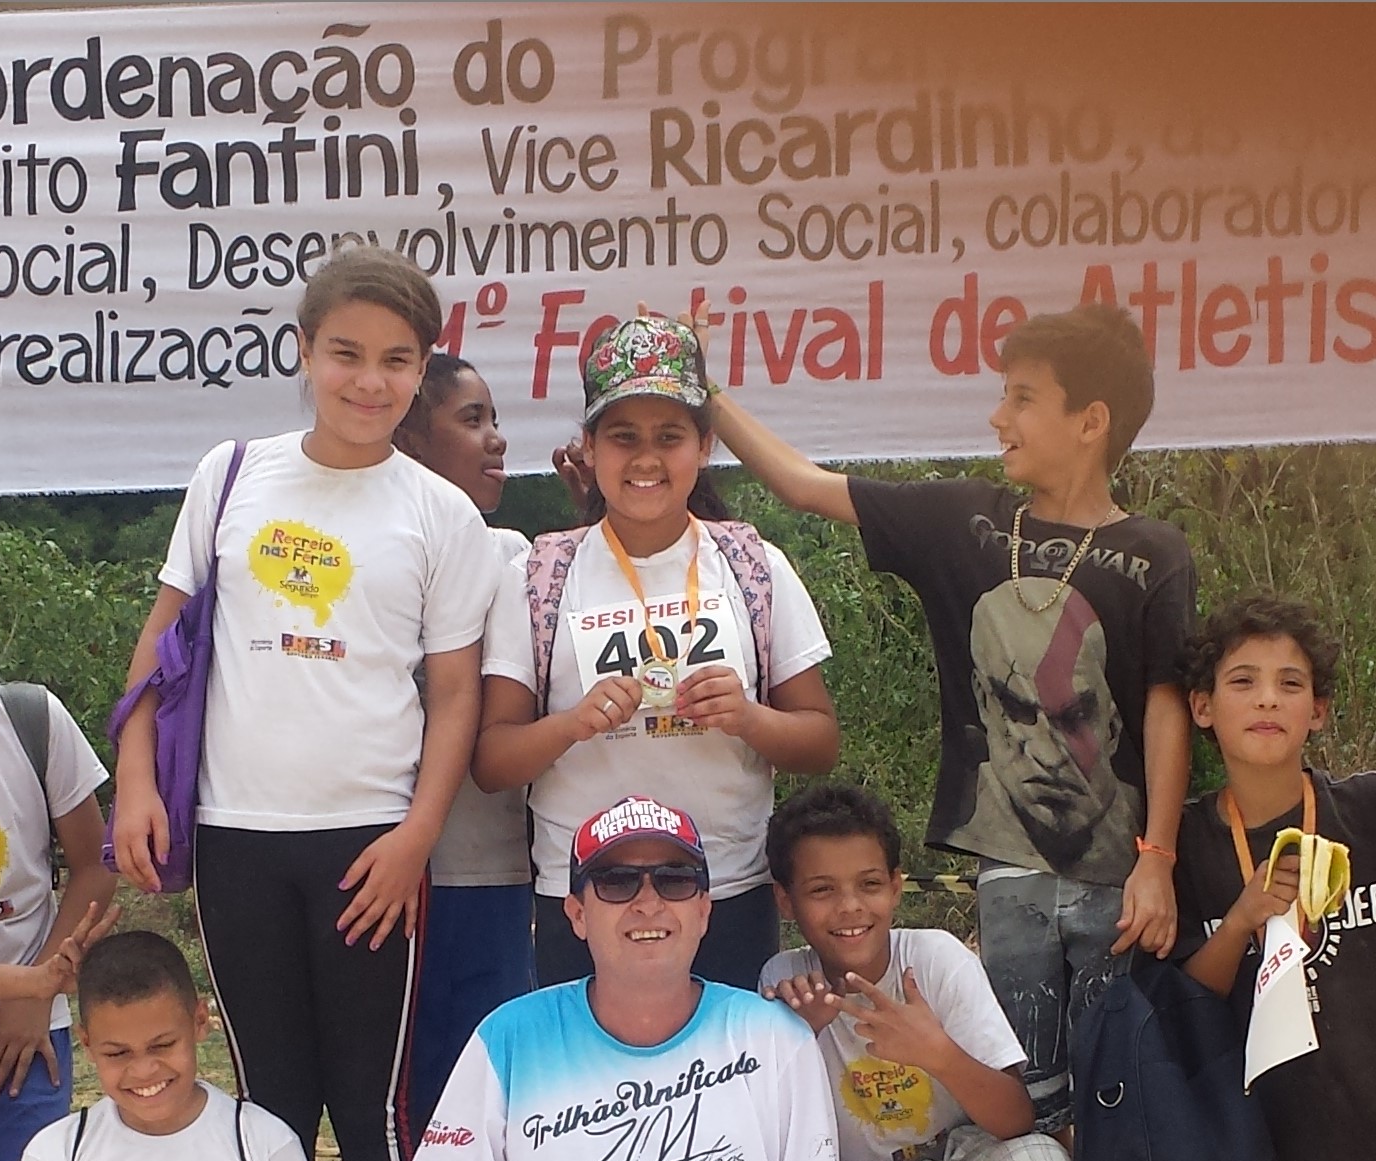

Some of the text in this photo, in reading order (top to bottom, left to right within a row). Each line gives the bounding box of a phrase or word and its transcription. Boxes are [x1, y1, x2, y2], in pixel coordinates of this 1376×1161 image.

[453, 19, 556, 106] do
[603, 20, 934, 113] Progra
[482, 123, 620, 196] Vice
[757, 183, 965, 262] Social,
[531, 281, 884, 399] Fival
[929, 272, 1028, 375] de
[260, 544, 342, 568] nas Férias
[272, 528, 334, 552] Recreio
[1081, 546, 1152, 591] WAR
[581, 608, 634, 631] SESI
[595, 617, 726, 677] 402
[590, 801, 682, 837] DOMINICAN
[598, 814, 679, 844] REPUBLIC
[851, 1065, 905, 1085] Recreio
[523, 1050, 762, 1151] Trilhão Unificado
